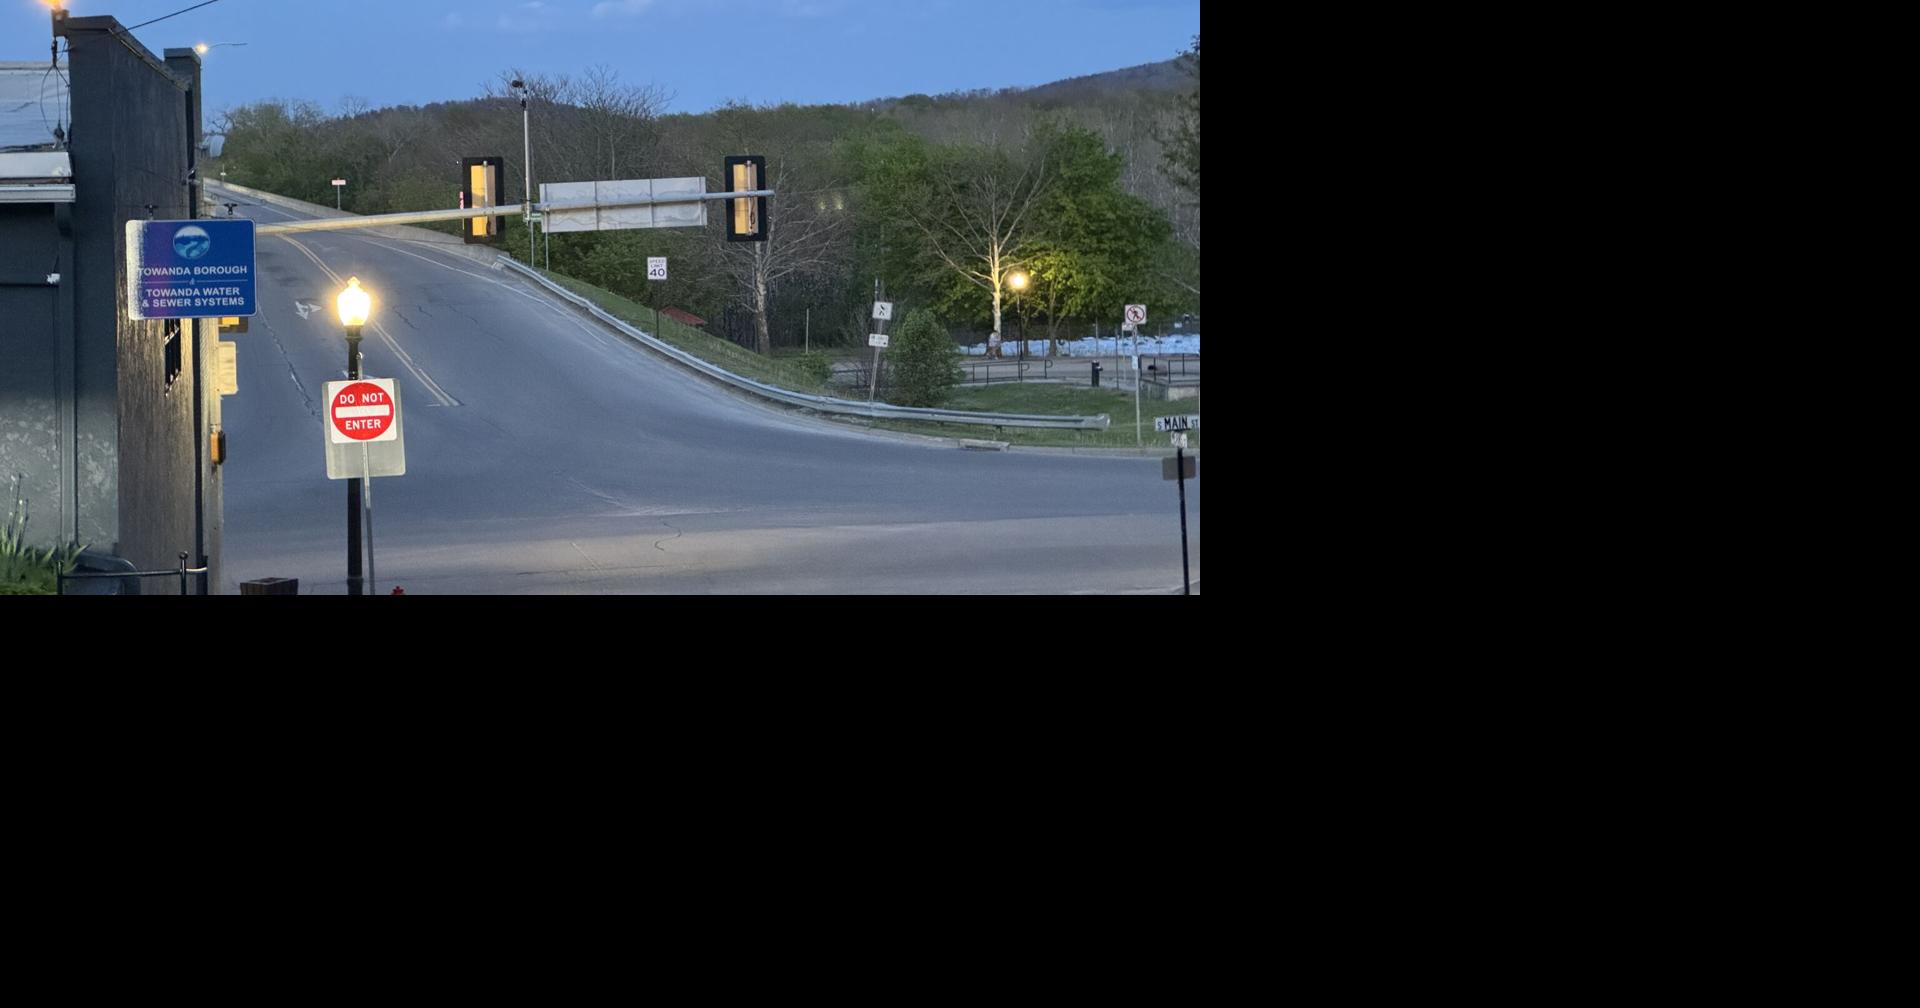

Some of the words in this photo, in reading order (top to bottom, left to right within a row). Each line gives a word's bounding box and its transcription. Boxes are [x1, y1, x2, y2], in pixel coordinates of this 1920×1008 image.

[138, 266, 191, 276] TOWANDA
[193, 265, 248, 275] BOROUGH
[649, 268, 665, 276] 40
[146, 288, 200, 298] TOWANDA
[203, 287, 240, 296] WATER
[142, 299, 149, 308] &
[153, 298, 191, 307] SEWER
[194, 297, 245, 306] SYSTEMS
[339, 394, 355, 405] DO
[361, 392, 384, 403] NOT
[345, 419, 382, 430] ENTER
[1157, 421, 1163, 431] S
[1164, 416, 1188, 430] MAIN
[1191, 419, 1199, 429] ST
